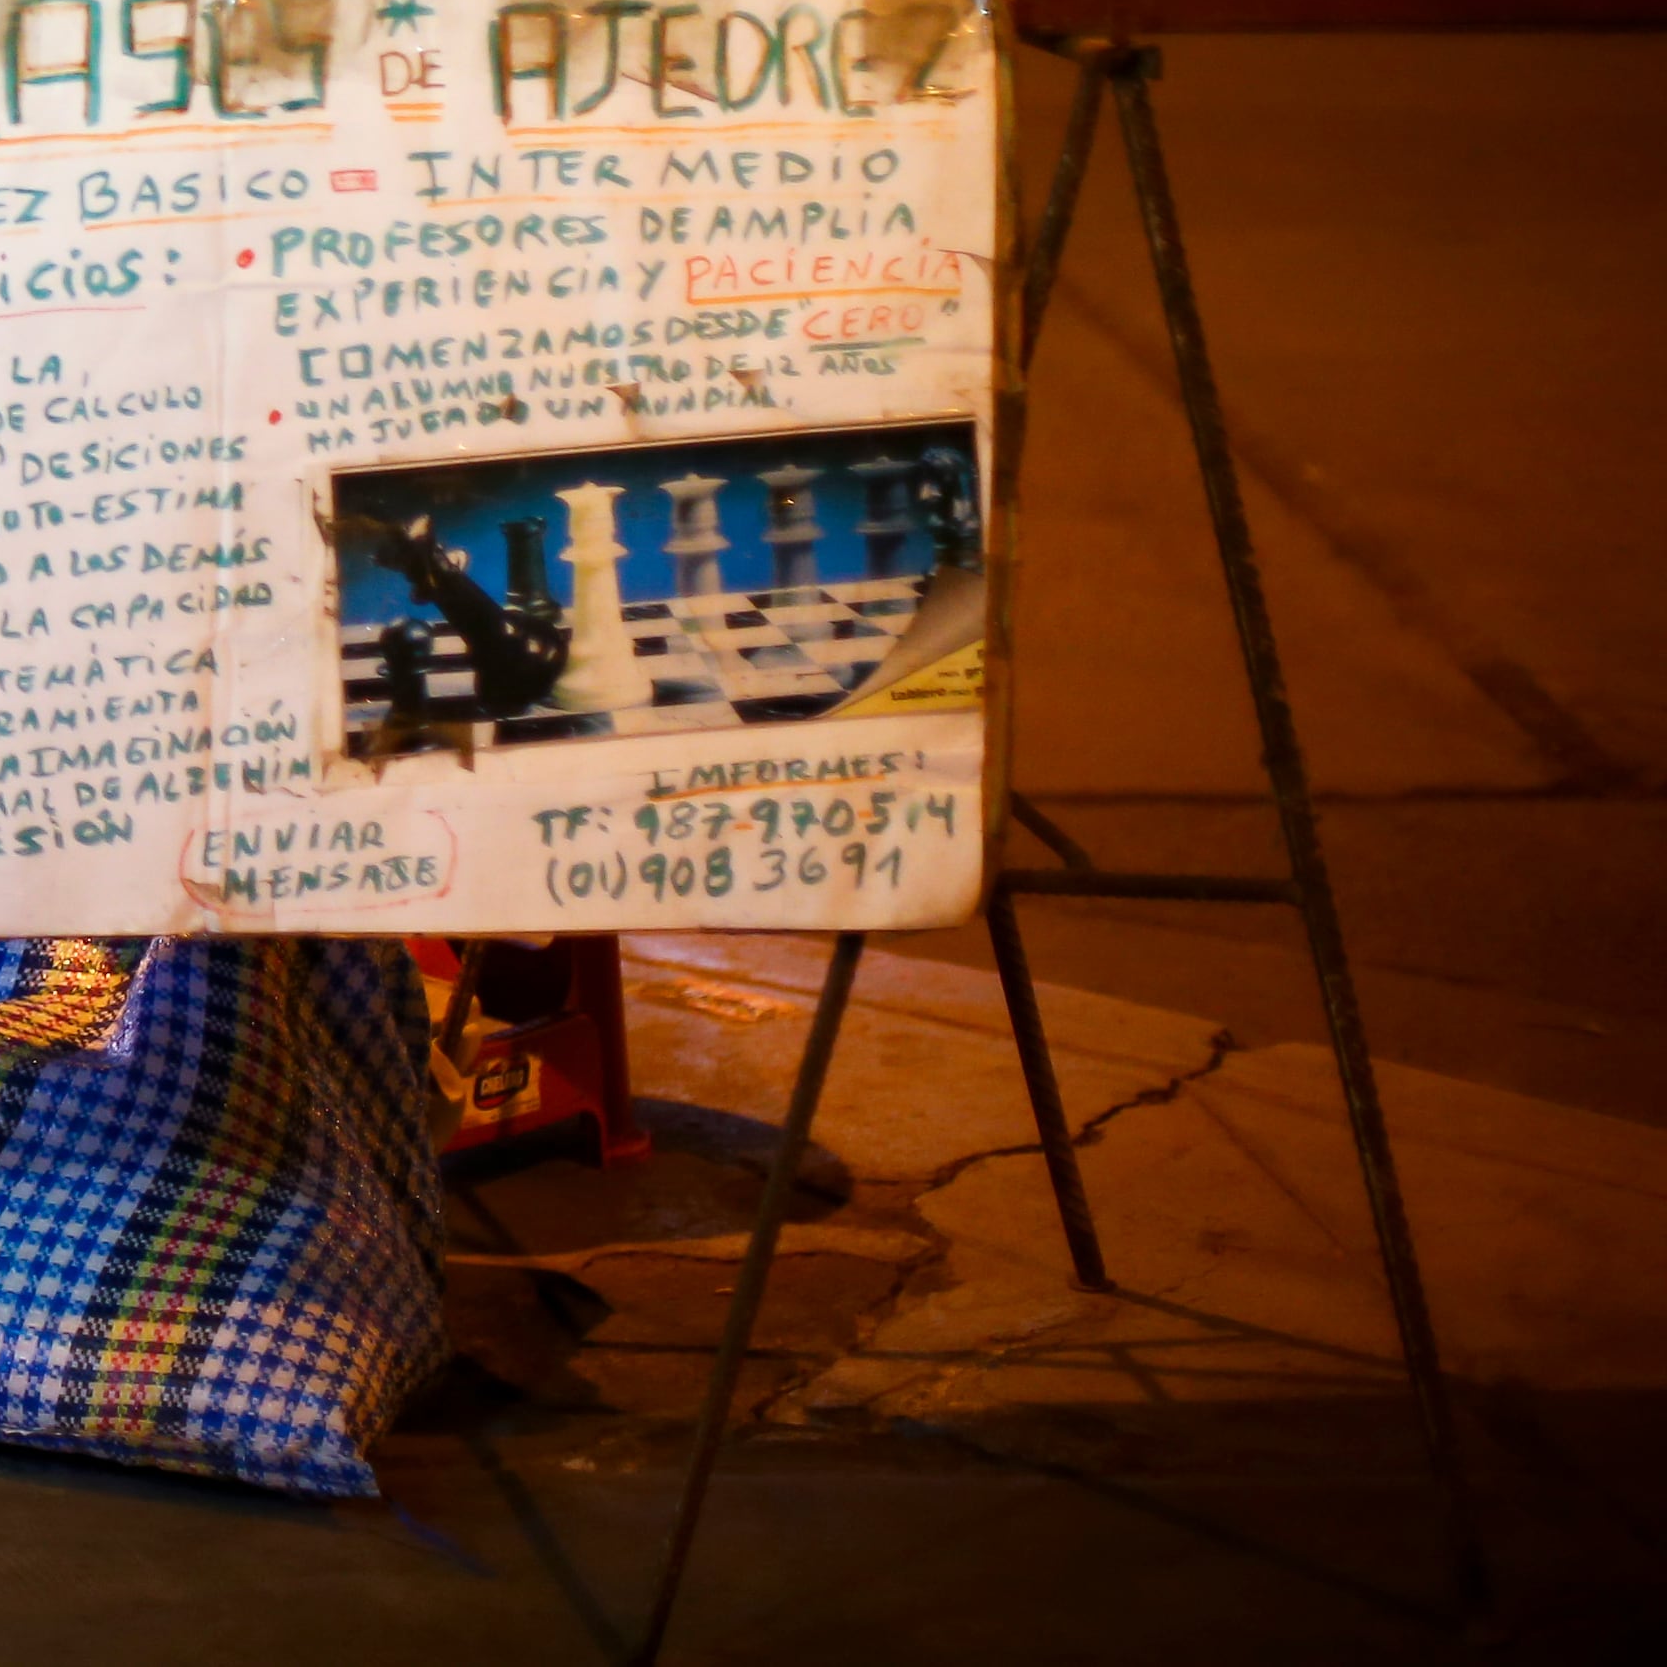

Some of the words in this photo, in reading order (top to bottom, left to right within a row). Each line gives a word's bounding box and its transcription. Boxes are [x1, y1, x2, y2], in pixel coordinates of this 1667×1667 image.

[378, 48, 446, 97] DE
[488, 0, 977, 125] AJEDREZ
[77, 168, 309, 223] BASICO
[271, 212, 608, 277] PROFESORES
[274, 252, 619, 337] EXPERIENCIA
[637, 259, 666, 301] Y
[684, 238, 964, 301] PACIENCIA
[11, 354, 62, 384] LA
[298, 320, 655, 386] COMENZAMOS
[666, 308, 791, 345] DESDE
[545, 395, 605, 420] UN
[28, 552, 54, 582] A
[0, 607, 50, 637] LA
[202, 821, 386, 867] ENVIAR
